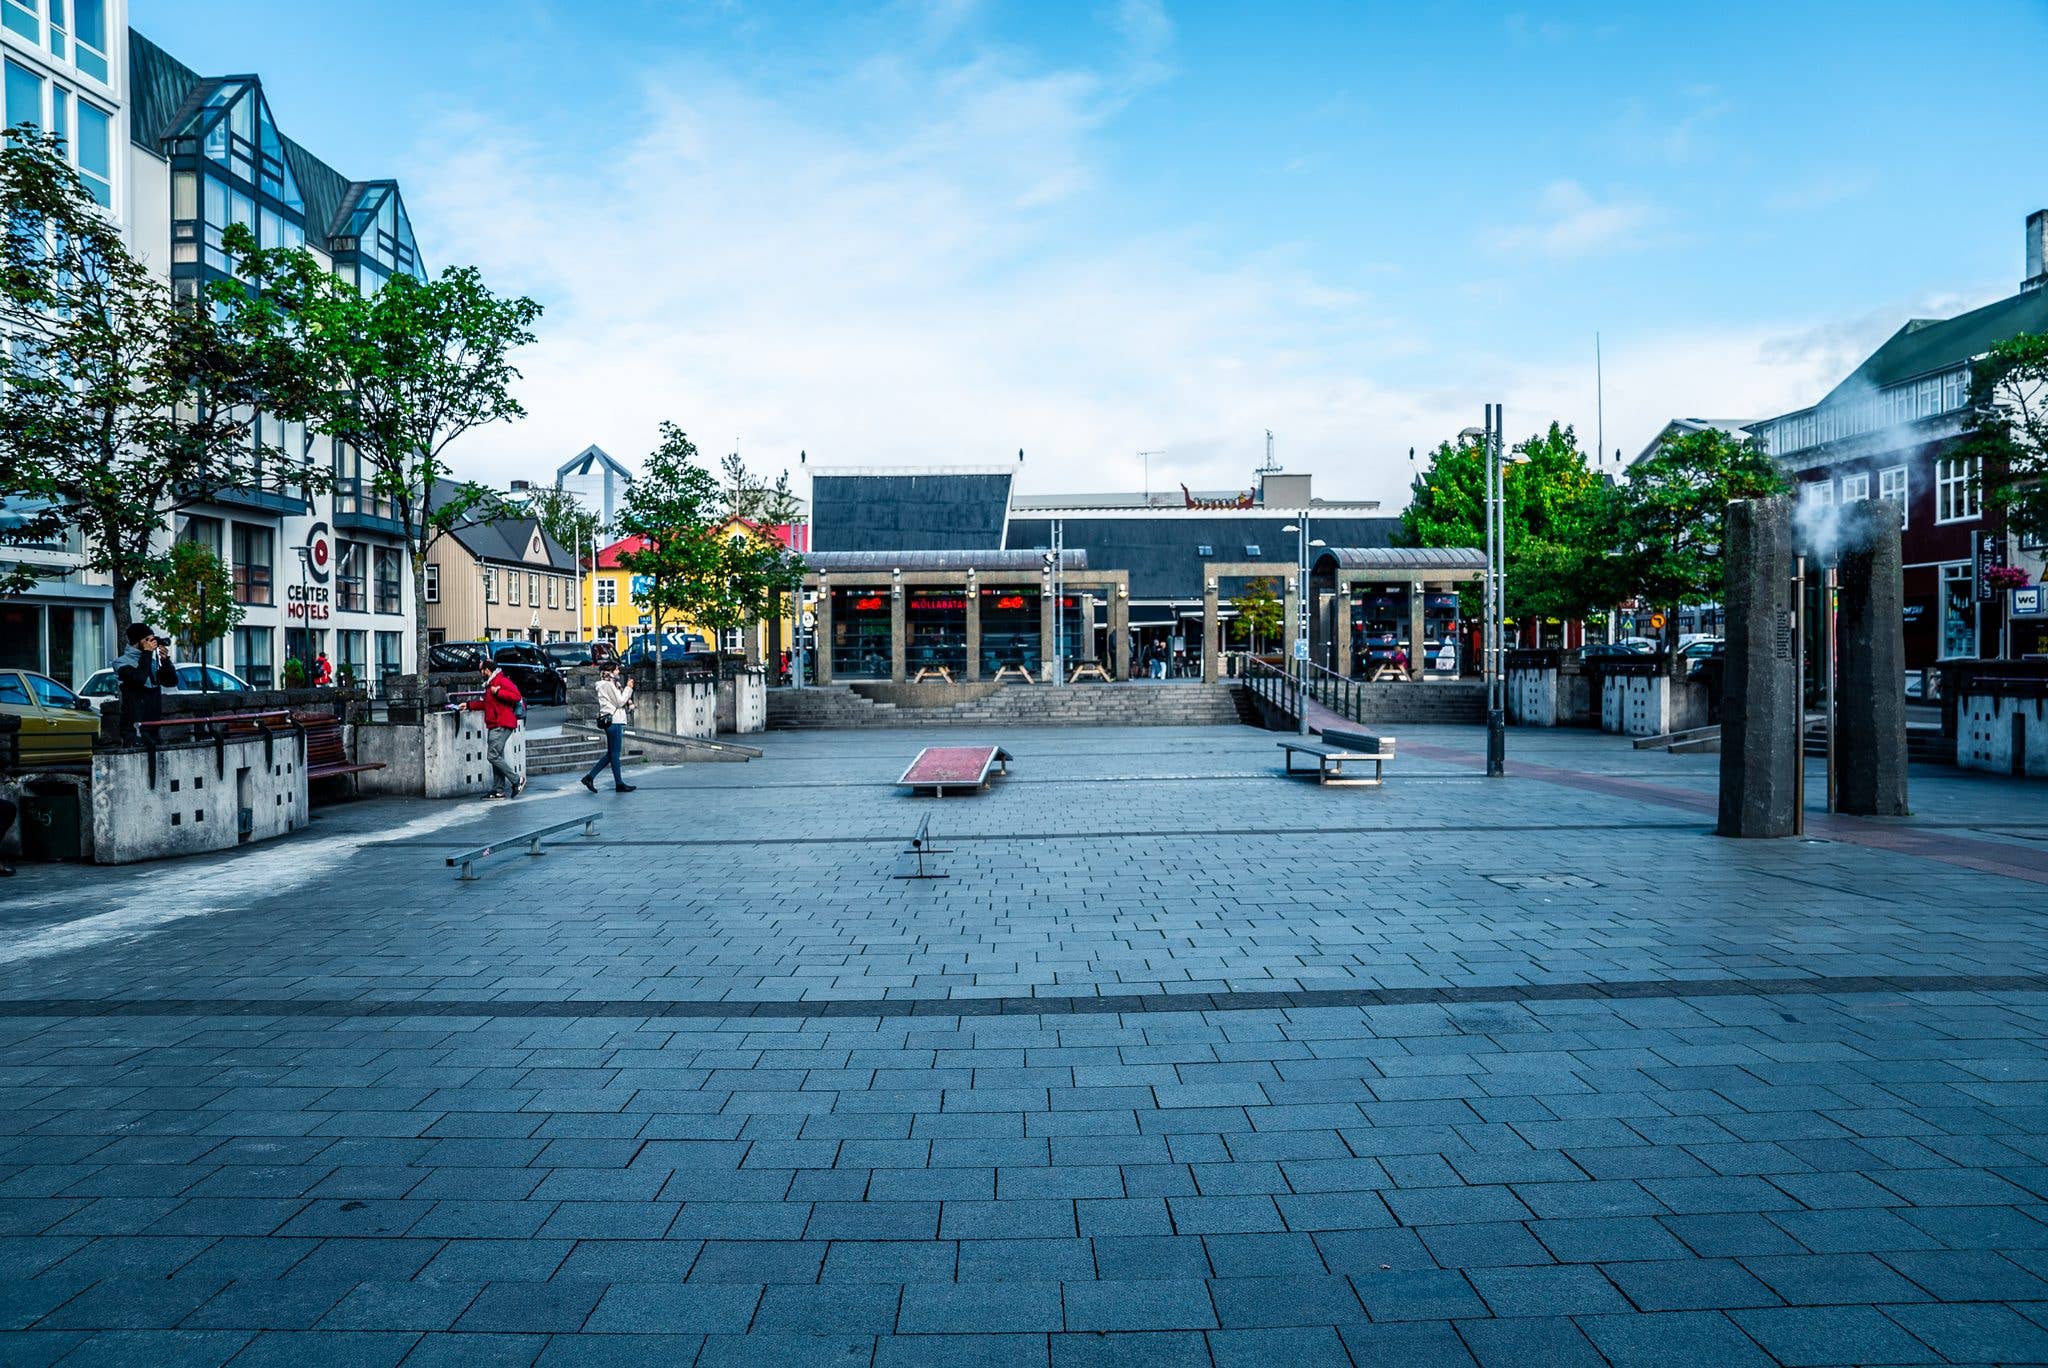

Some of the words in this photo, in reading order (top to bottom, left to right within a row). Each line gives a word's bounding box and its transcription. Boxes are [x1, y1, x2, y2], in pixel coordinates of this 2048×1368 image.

[287, 585, 329, 602] CENTER
[2018, 596, 2036, 604] WC
[287, 602, 329, 620] HOTELS
